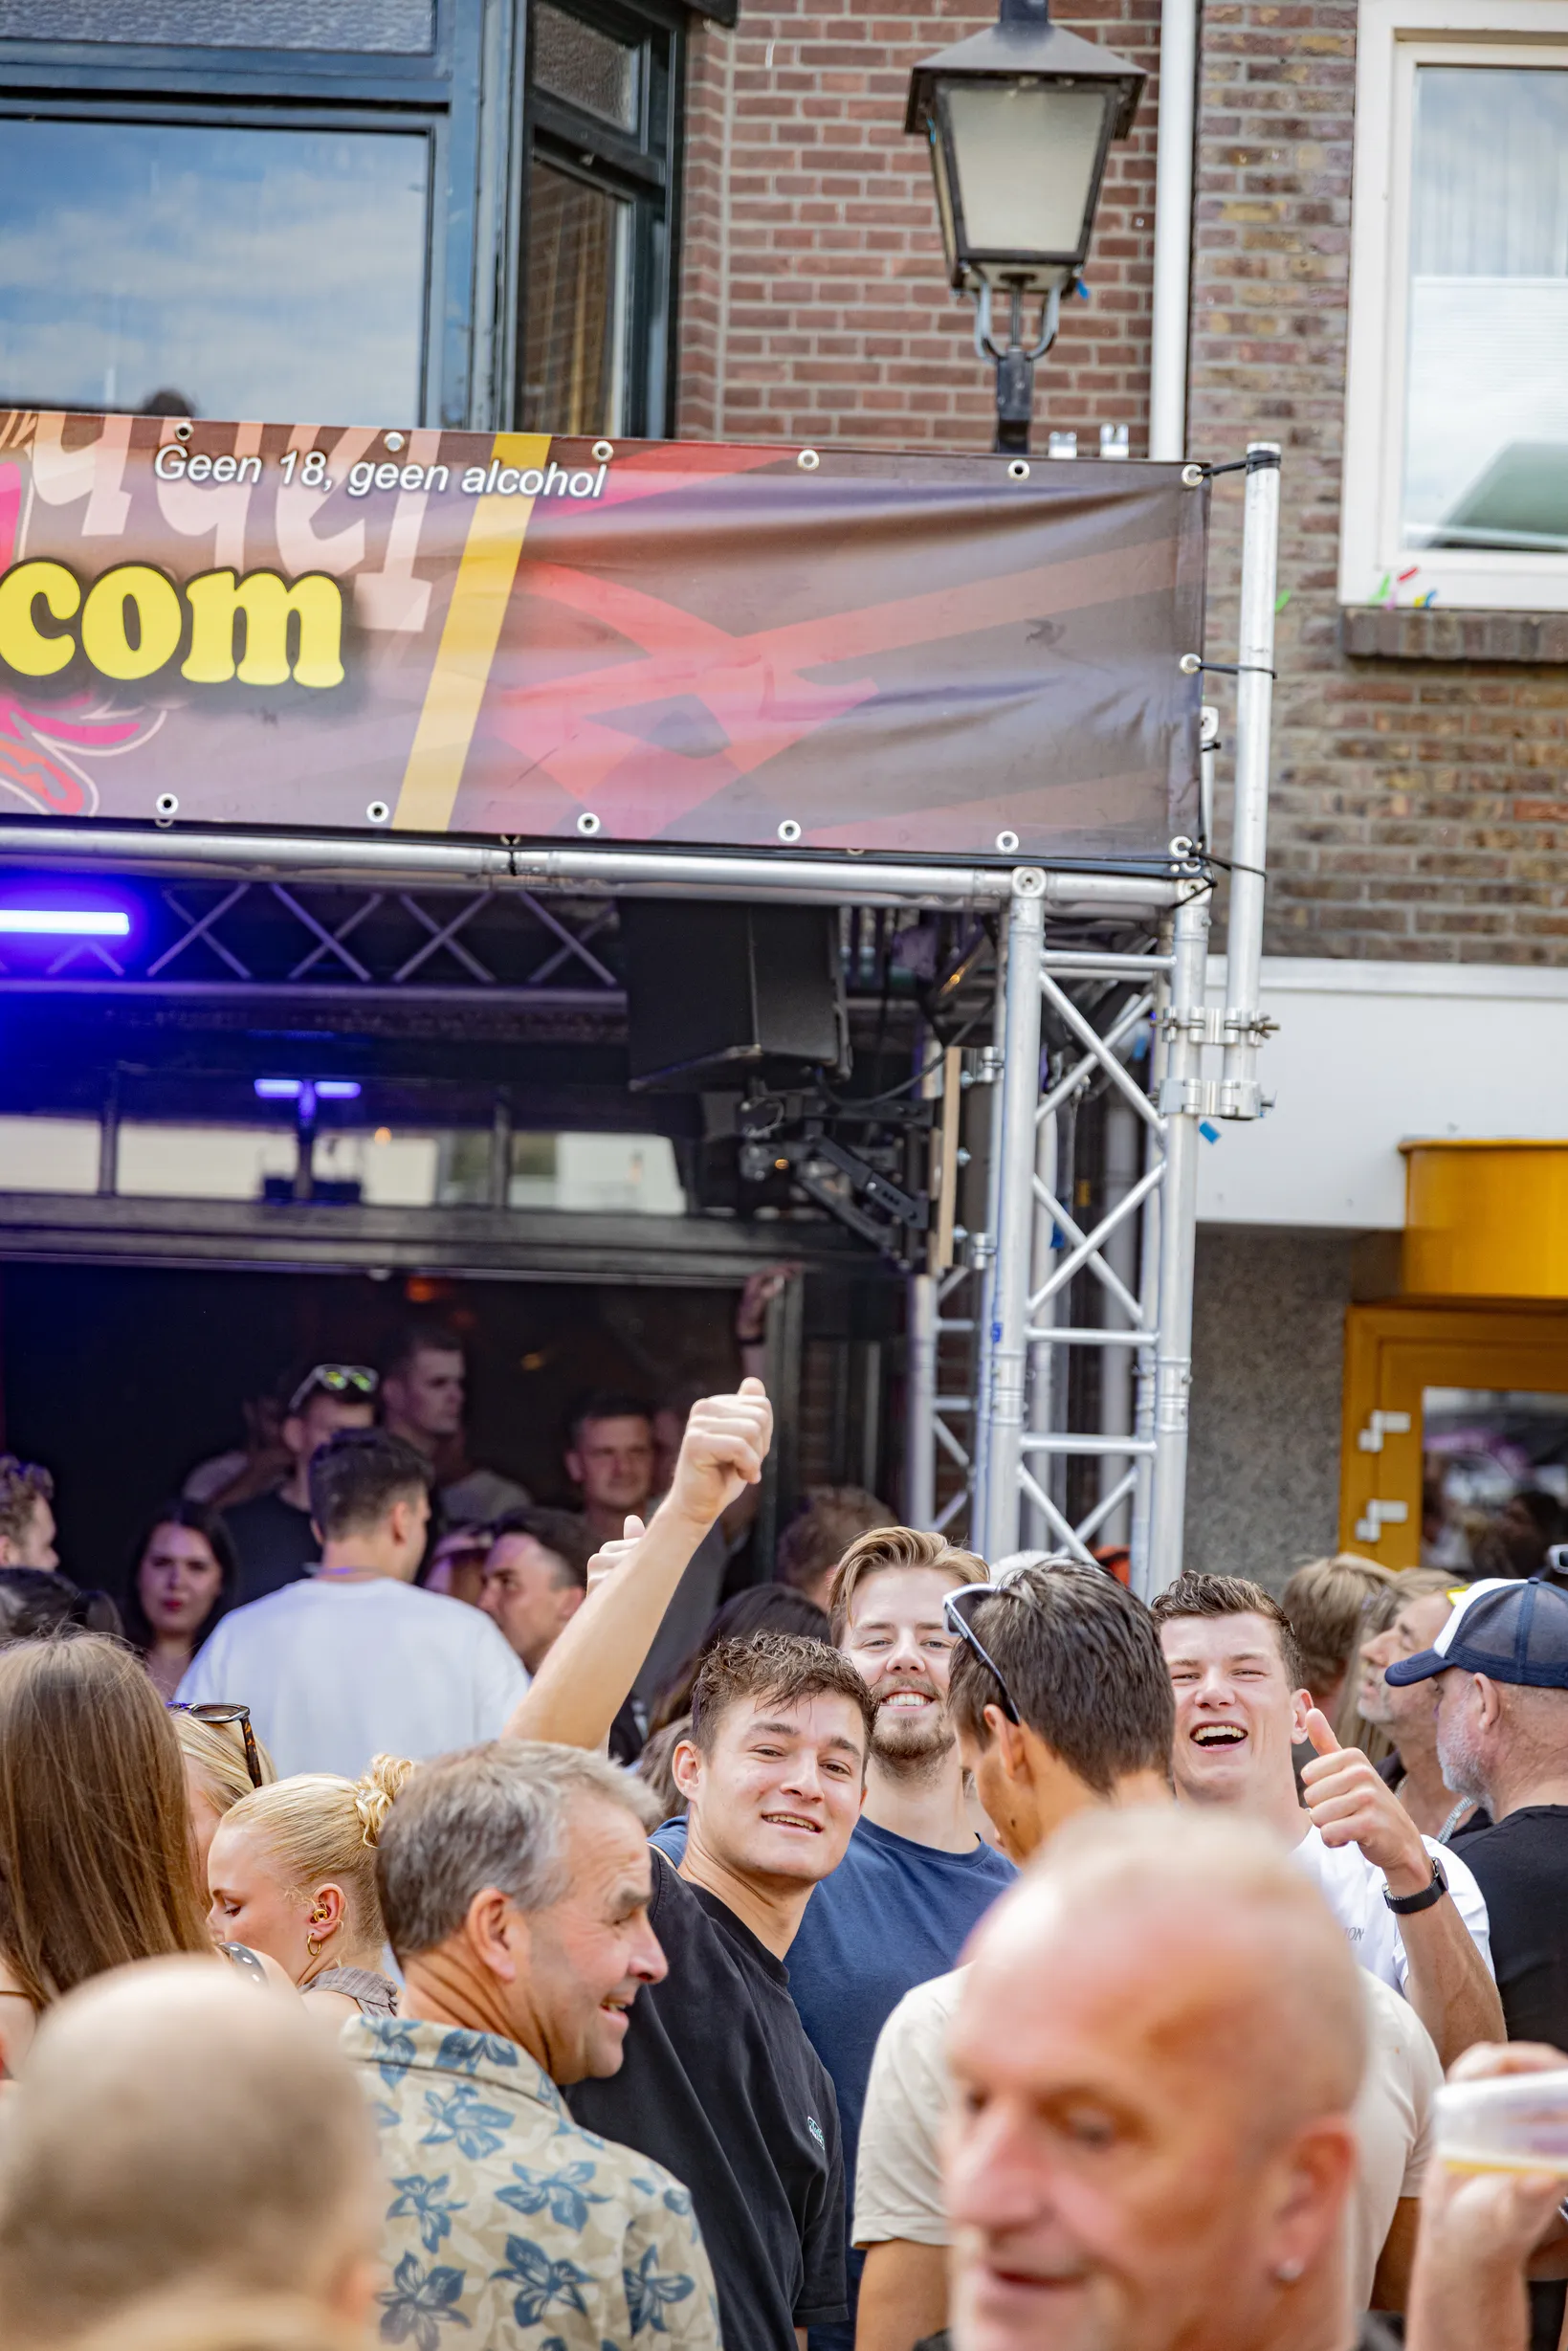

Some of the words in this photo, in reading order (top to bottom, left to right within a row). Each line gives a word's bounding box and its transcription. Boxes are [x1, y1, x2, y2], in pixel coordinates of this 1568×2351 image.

[155, 444, 263, 484] Geen
[279, 450, 333, 492] 18,
[347, 460, 450, 497] geen
[461, 458, 607, 499] alcohol
